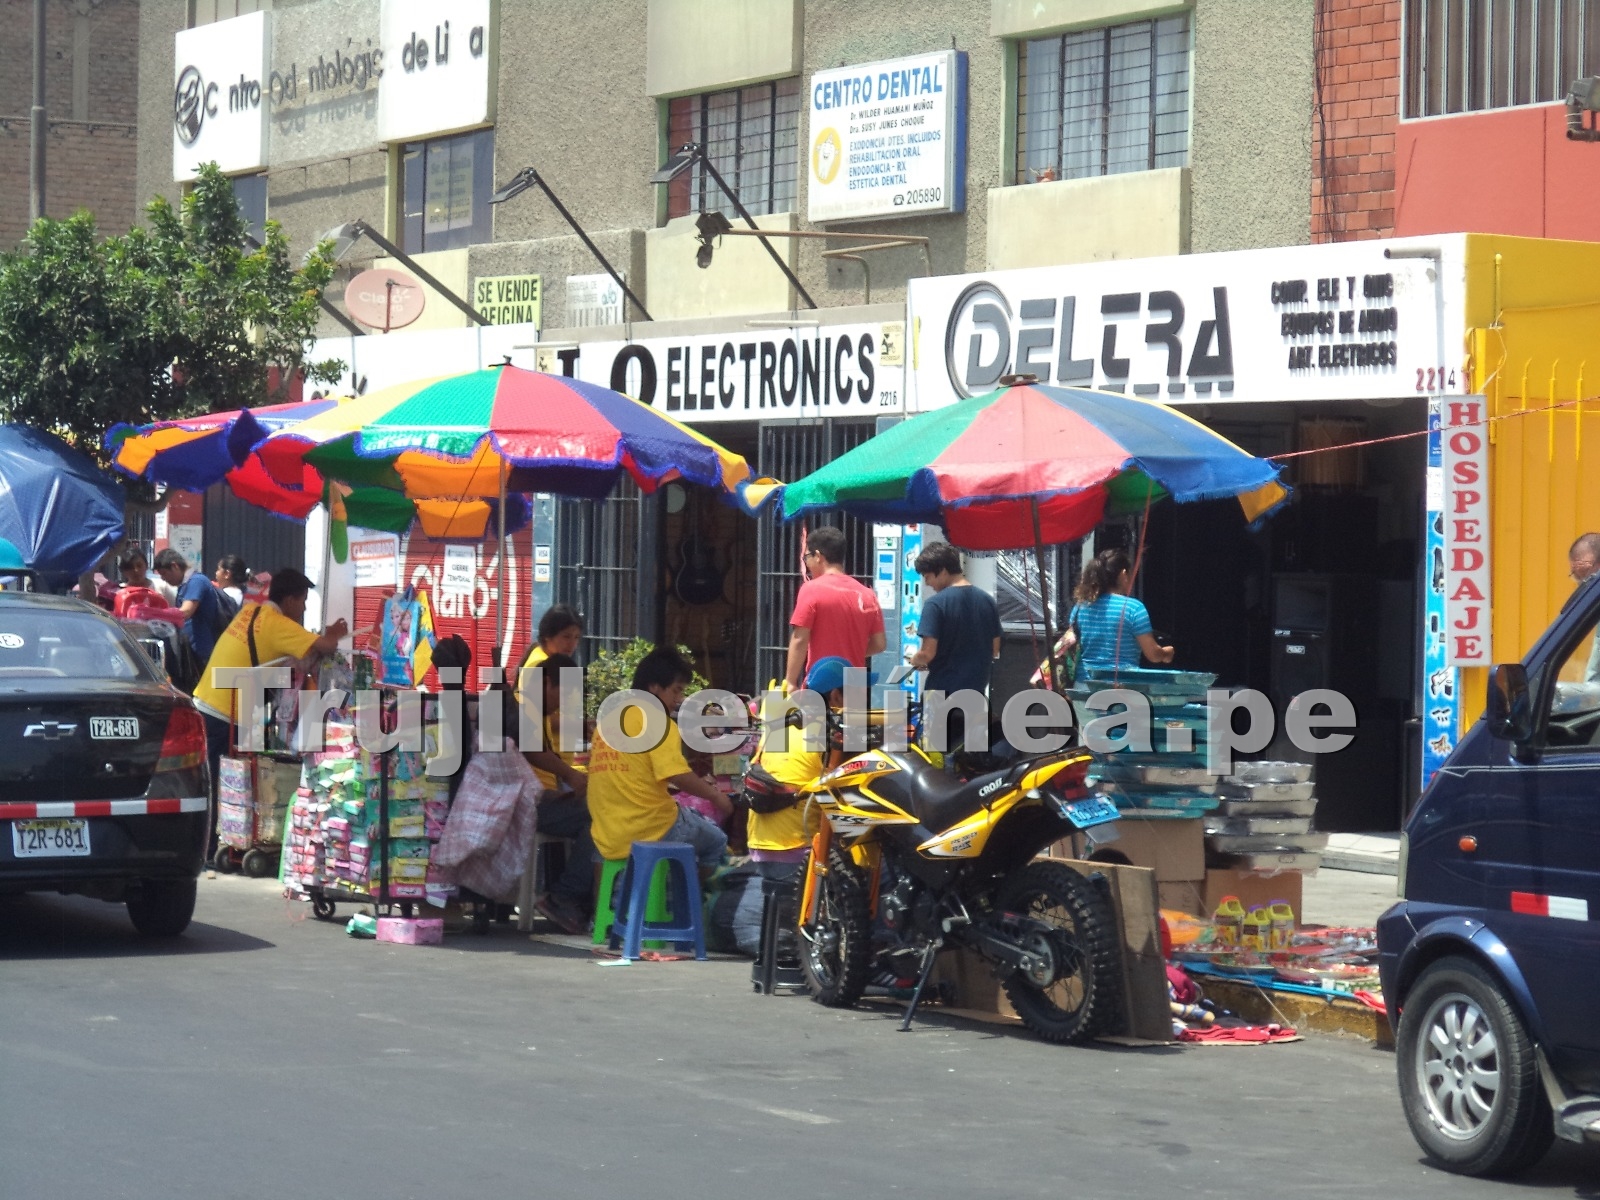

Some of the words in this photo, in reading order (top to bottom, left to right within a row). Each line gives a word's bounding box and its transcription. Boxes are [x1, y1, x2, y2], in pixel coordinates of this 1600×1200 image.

[402, 32, 428, 74] de
[814, 75, 873, 111] CENTRO
[878, 65, 943, 101] DENTAL
[858, 108, 881, 119] WILDER
[913, 99, 934, 111] MUÑOZ
[861, 122, 877, 132] SUSY
[901, 116, 925, 127] CHOQUE
[850, 138, 885, 151] EXODONCIA
[907, 130, 941, 144] INCLUIDOS
[850, 150, 901, 164] REHABILITACION
[903, 147, 921, 158] ORAL
[897, 161, 906, 171] RX
[850, 177, 879, 190] ESTETICA
[881, 174, 907, 186] DENTAL
[906, 187, 942, 205] 205890
[359, 291, 403, 304] Clao
[478, 281, 493, 304] SE
[497, 279, 538, 303] VENDE
[1281, 311, 1335, 339] EQUIPOS
[1339, 310, 1355, 334] DE
[1358, 306, 1398, 332] AUDIO
[964, 286, 1235, 386] DELTRA
[1318, 341, 1397, 368] ELECTRICOS
[666, 332, 875, 411] ELECTRONICS
[1415, 367, 1456, 391] 2214
[880, 391, 897, 407] 2216
[1447, 402, 1486, 661] HOSPEDAJE
[92, 718, 139, 737] T2R-681
[16, 828, 85, 851] T2R-681
